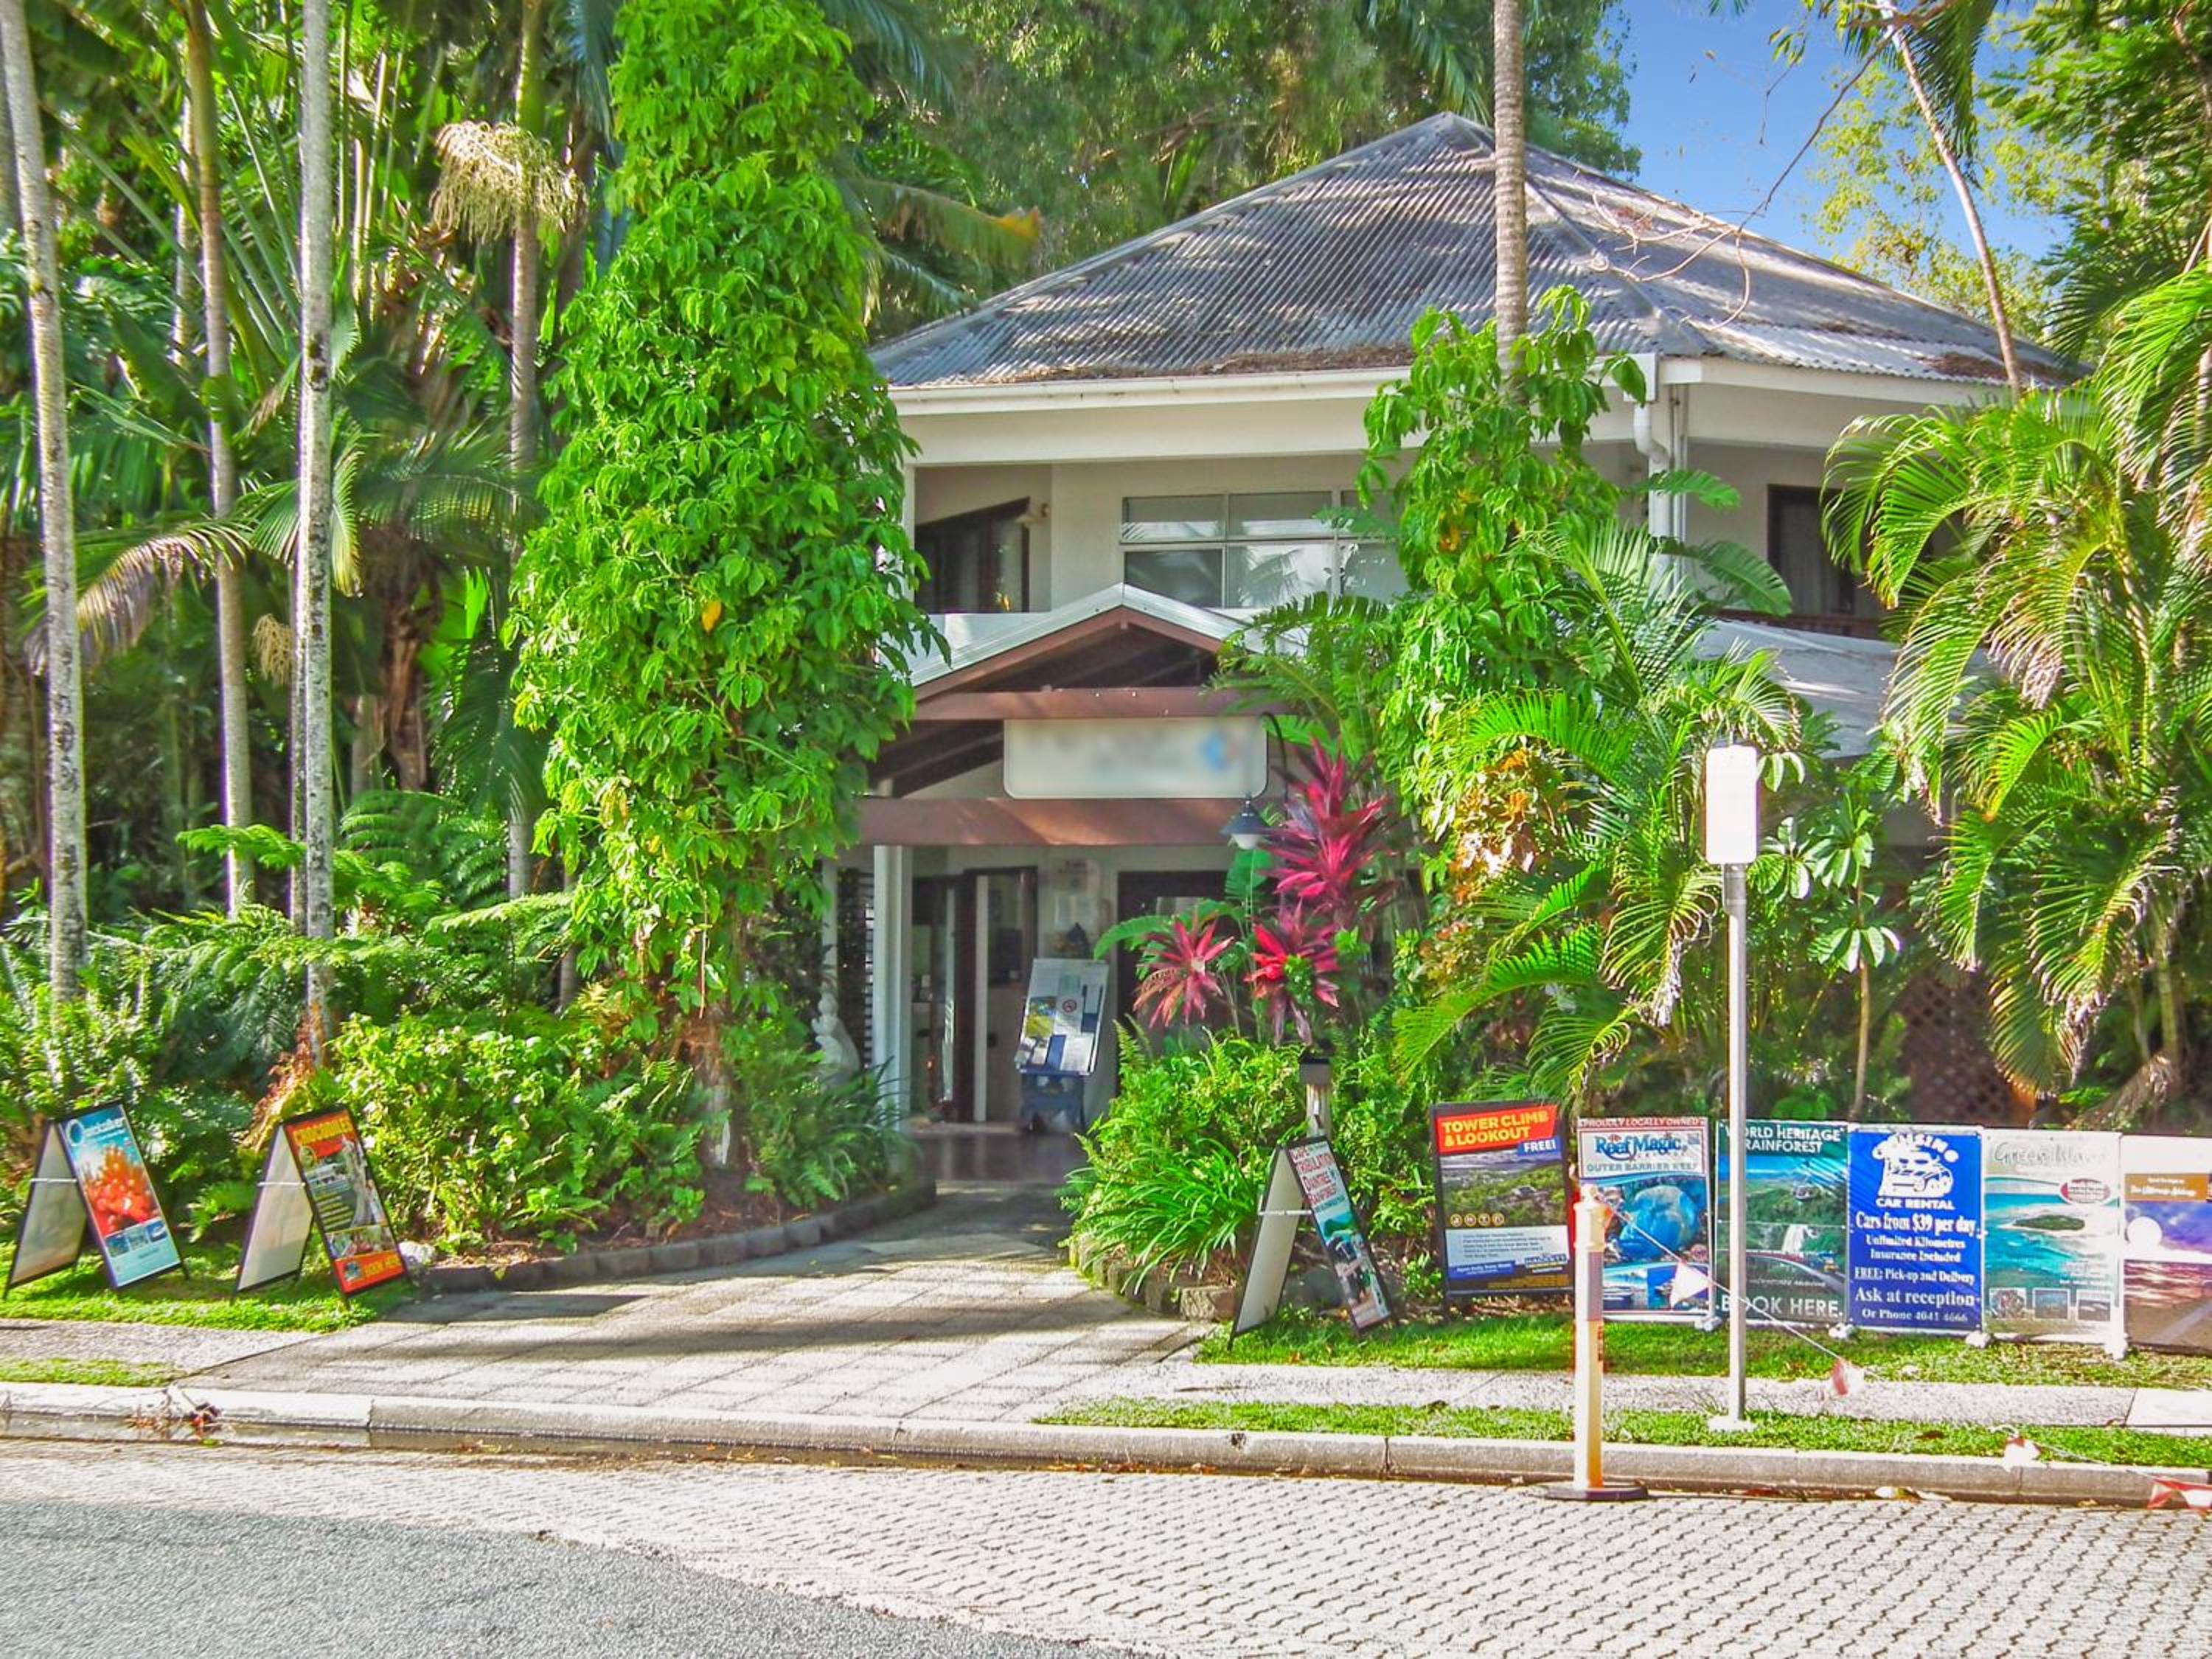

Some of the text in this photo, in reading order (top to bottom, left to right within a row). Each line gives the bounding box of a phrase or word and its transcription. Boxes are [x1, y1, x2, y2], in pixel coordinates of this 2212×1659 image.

[1442, 1110, 1549, 1133] TOWER CLIMB
[1626, 1117, 1666, 1127] LOCALLY
[1666, 1117, 1699, 1126] OWNED
[1444, 1127, 1531, 1147] & LOOKOUT
[1776, 1124, 1841, 1142] HERITAGE
[1523, 1139, 1557, 1152] FREE!
[1595, 1134, 1682, 1161] Reef Magic
[1745, 1139, 1823, 1154] RAINFOREST
[1587, 1164, 1622, 1172] OUTER
[1624, 1162, 1669, 1171] BARRIER
[1876, 1197, 1955, 1210] CAR RENTAL
[1855, 1211, 1976, 1237] Cars from $39 per day
[1866, 1234, 1966, 1248] Unlimited Kilometres
[1871, 1249, 1961, 1262] Insurance Included
[1885, 1268, 1918, 1283] Pick-up
[1920, 1270, 1937, 1280] and
[1938, 1271, 1975, 1285] Delivery
[1855, 1287, 1975, 1308] Ask at reception
[1862, 1308, 1877, 1318] Or
[1880, 1309, 1912, 1320] Phone
